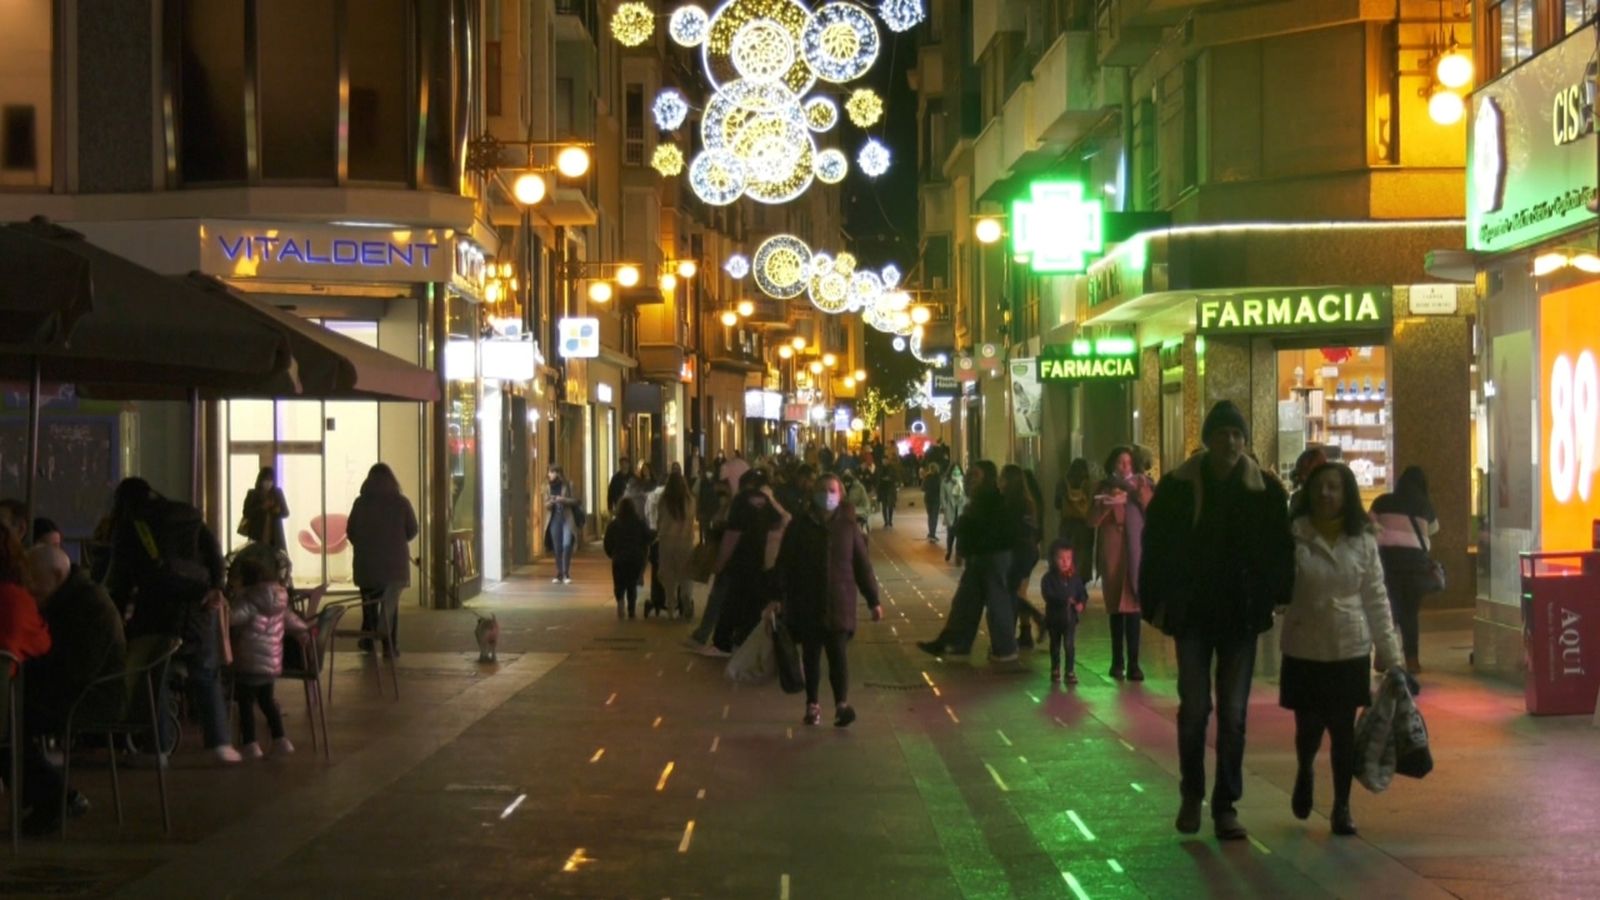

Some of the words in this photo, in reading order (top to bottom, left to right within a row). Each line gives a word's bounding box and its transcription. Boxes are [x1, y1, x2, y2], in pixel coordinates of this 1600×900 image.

[218, 235, 439, 268] VITALDENT
[1201, 292, 1380, 329] FARMACIA
[1040, 358, 1135, 379] FARMACIA
[1559, 607, 1584, 675] AQUÍ
